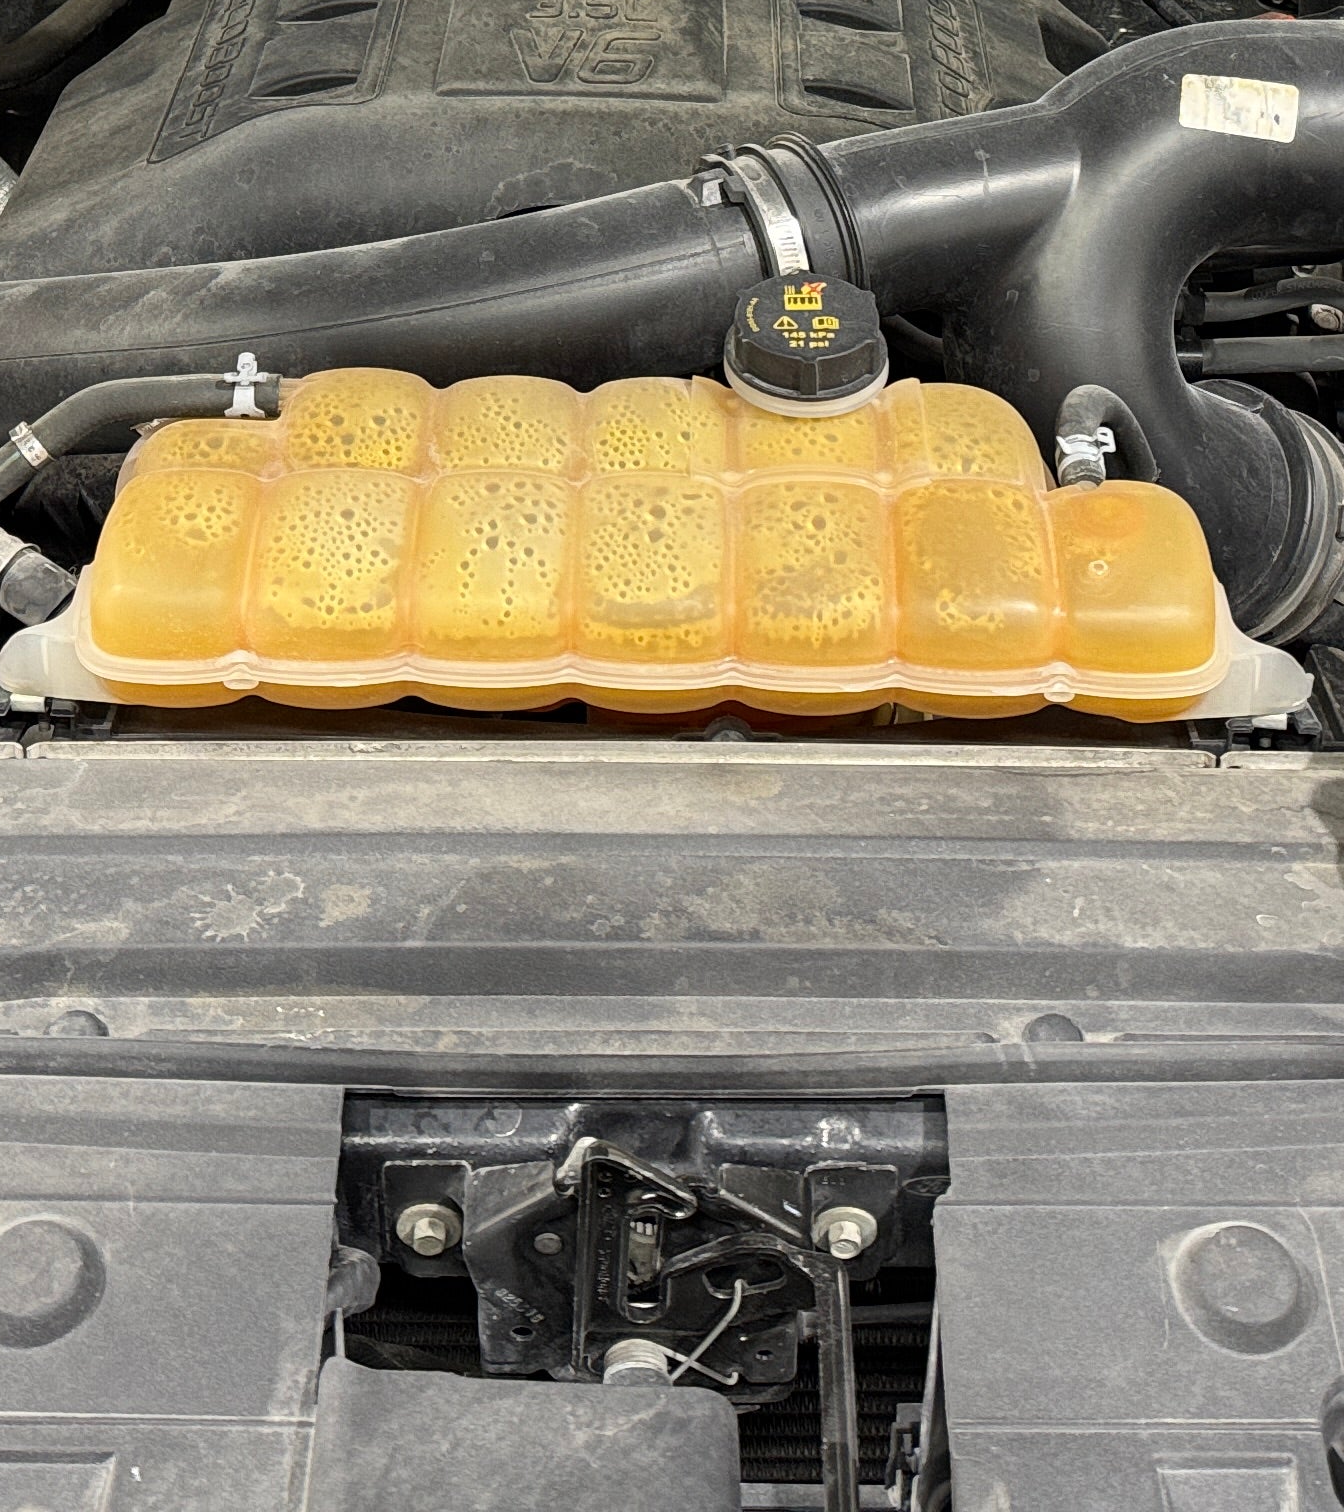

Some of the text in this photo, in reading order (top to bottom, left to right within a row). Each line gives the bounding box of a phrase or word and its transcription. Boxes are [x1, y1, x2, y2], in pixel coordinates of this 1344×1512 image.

[509, 28, 662, 85] V6
[809, 331, 835, 339] kPa
[789, 340, 829, 349] 21 psi
